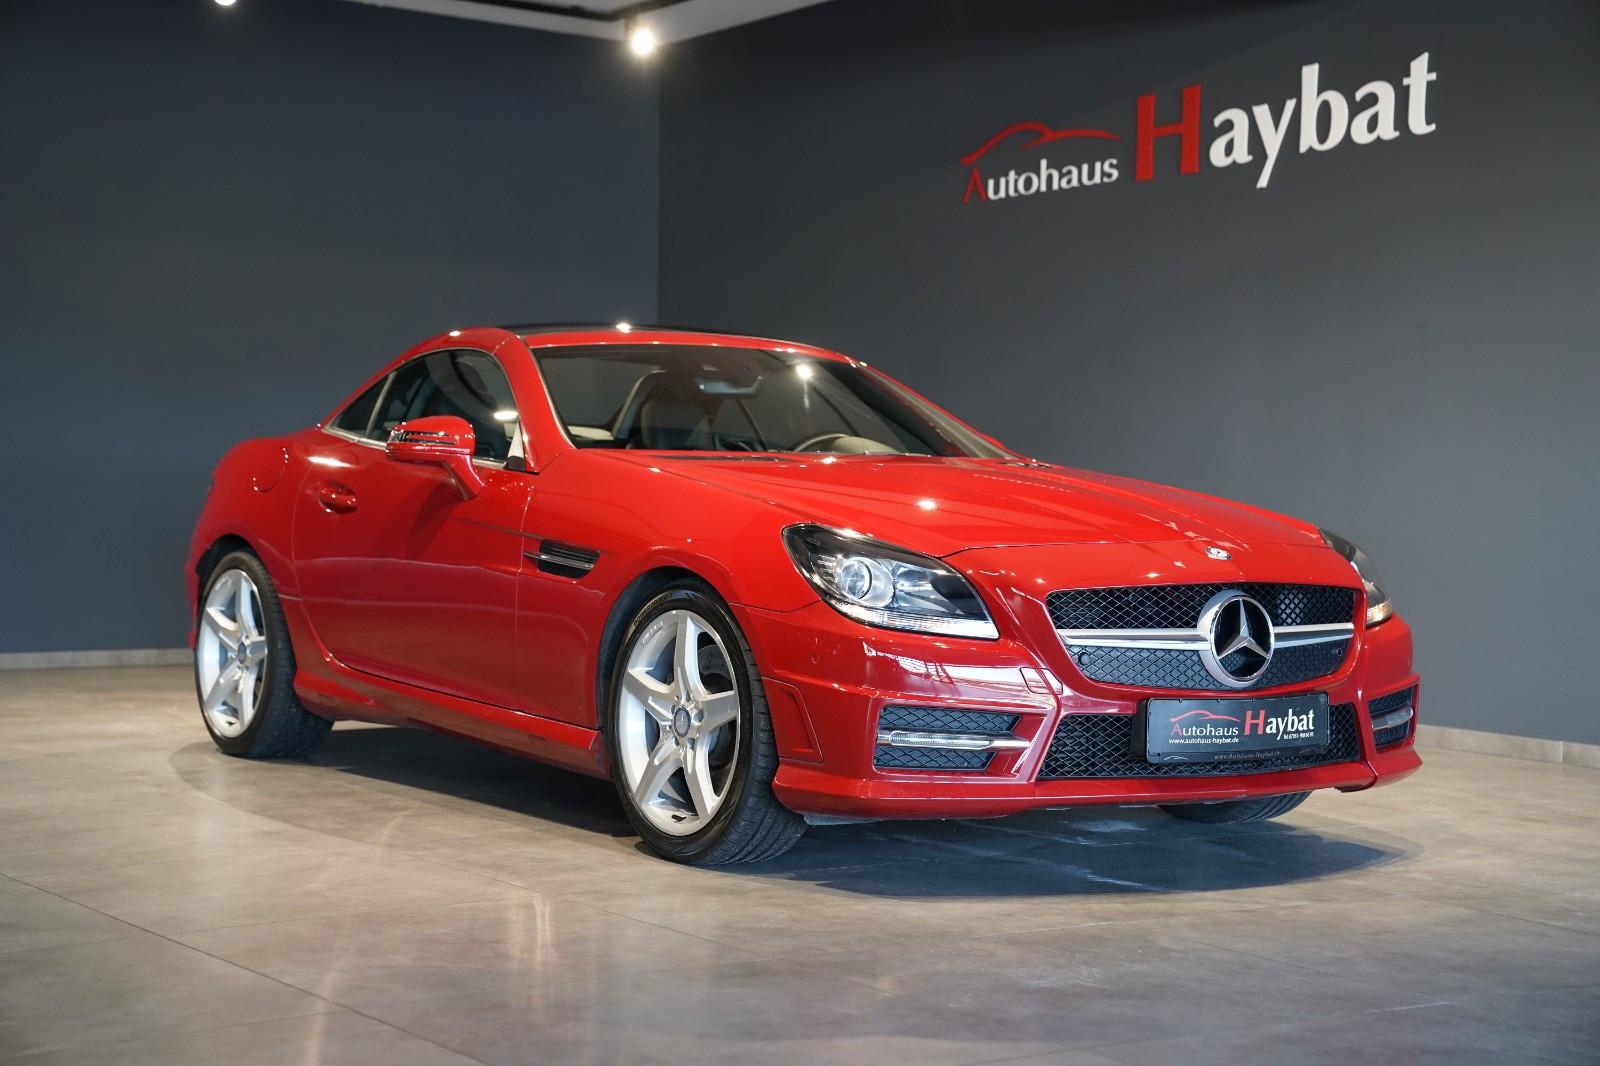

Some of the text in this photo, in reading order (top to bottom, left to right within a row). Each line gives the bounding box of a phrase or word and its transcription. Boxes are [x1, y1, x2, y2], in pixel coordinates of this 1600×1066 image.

[962, 52, 1437, 204] Autohaus Haybat
[1170, 709, 1315, 740] Autohaus Haybat
